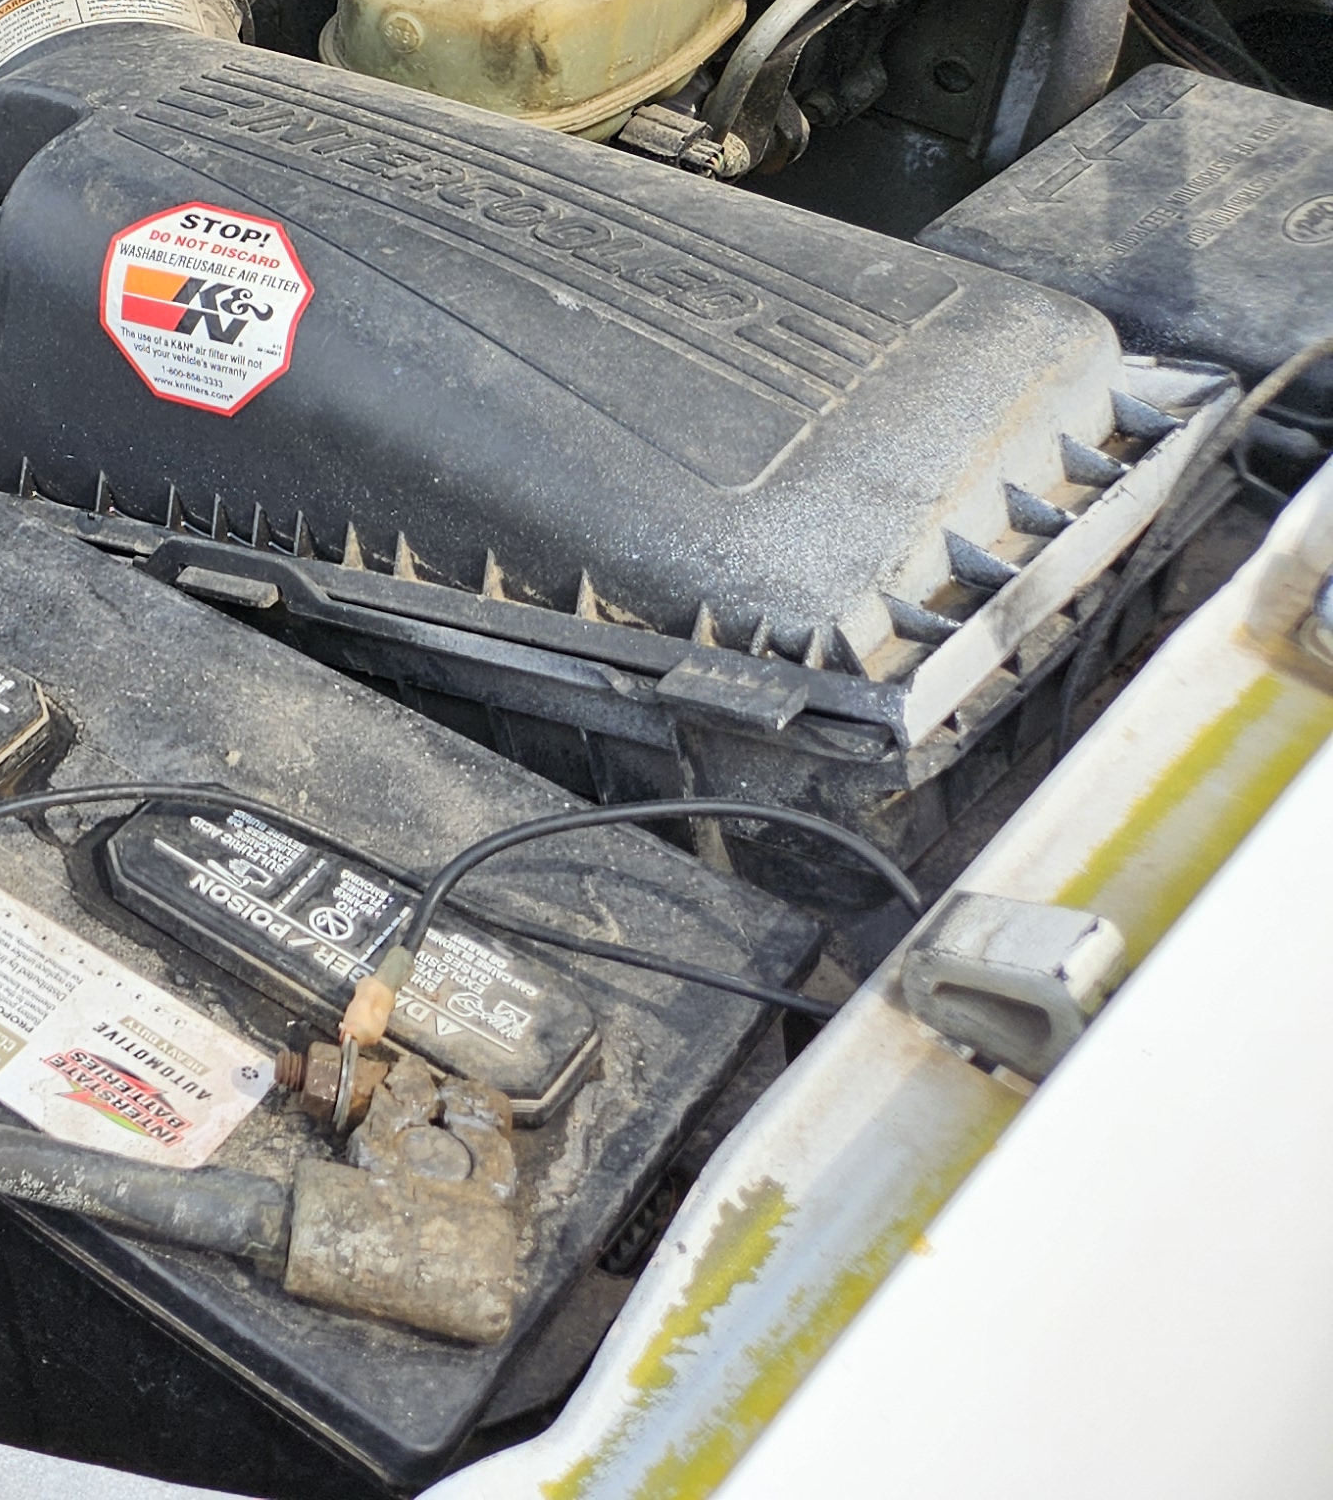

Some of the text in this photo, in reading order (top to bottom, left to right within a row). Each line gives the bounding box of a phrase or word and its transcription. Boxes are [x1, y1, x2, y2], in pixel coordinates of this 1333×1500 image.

[148, 228, 281, 270] DO NOT DISCARD
[178, 210, 271, 249] STOP!
[118, 240, 300, 294] WASHABLE/REUSABLE AIR FILTER
[120, 326, 136, 339] The
[135, 330, 153, 343] use
[153, 334, 164, 346] of
[162, 337, 170, 347] a
[194, 344, 207, 356] air
[207, 348, 229, 362] filter
[229, 353, 246, 366] will
[246, 358, 263, 370] not
[132, 341, 248, 381] void your vehicle's warranty
[218, 830, 287, 875] SULFURIC
[186, 870, 292, 941] POISON
[333, 898, 360, 919] NO
[310, 942, 431, 1024] DAGER
[414, 947, 486, 995] EXPLOSIV
[440, 950, 493, 987] GASES
[91, 1019, 213, 1103] AUTOMOTIVE
[122, 1017, 206, 1074] HEAVY DUTY
[47, 1053, 180, 1146] INTERSTATE
[67, 1047, 187, 1131] BATTERIES
